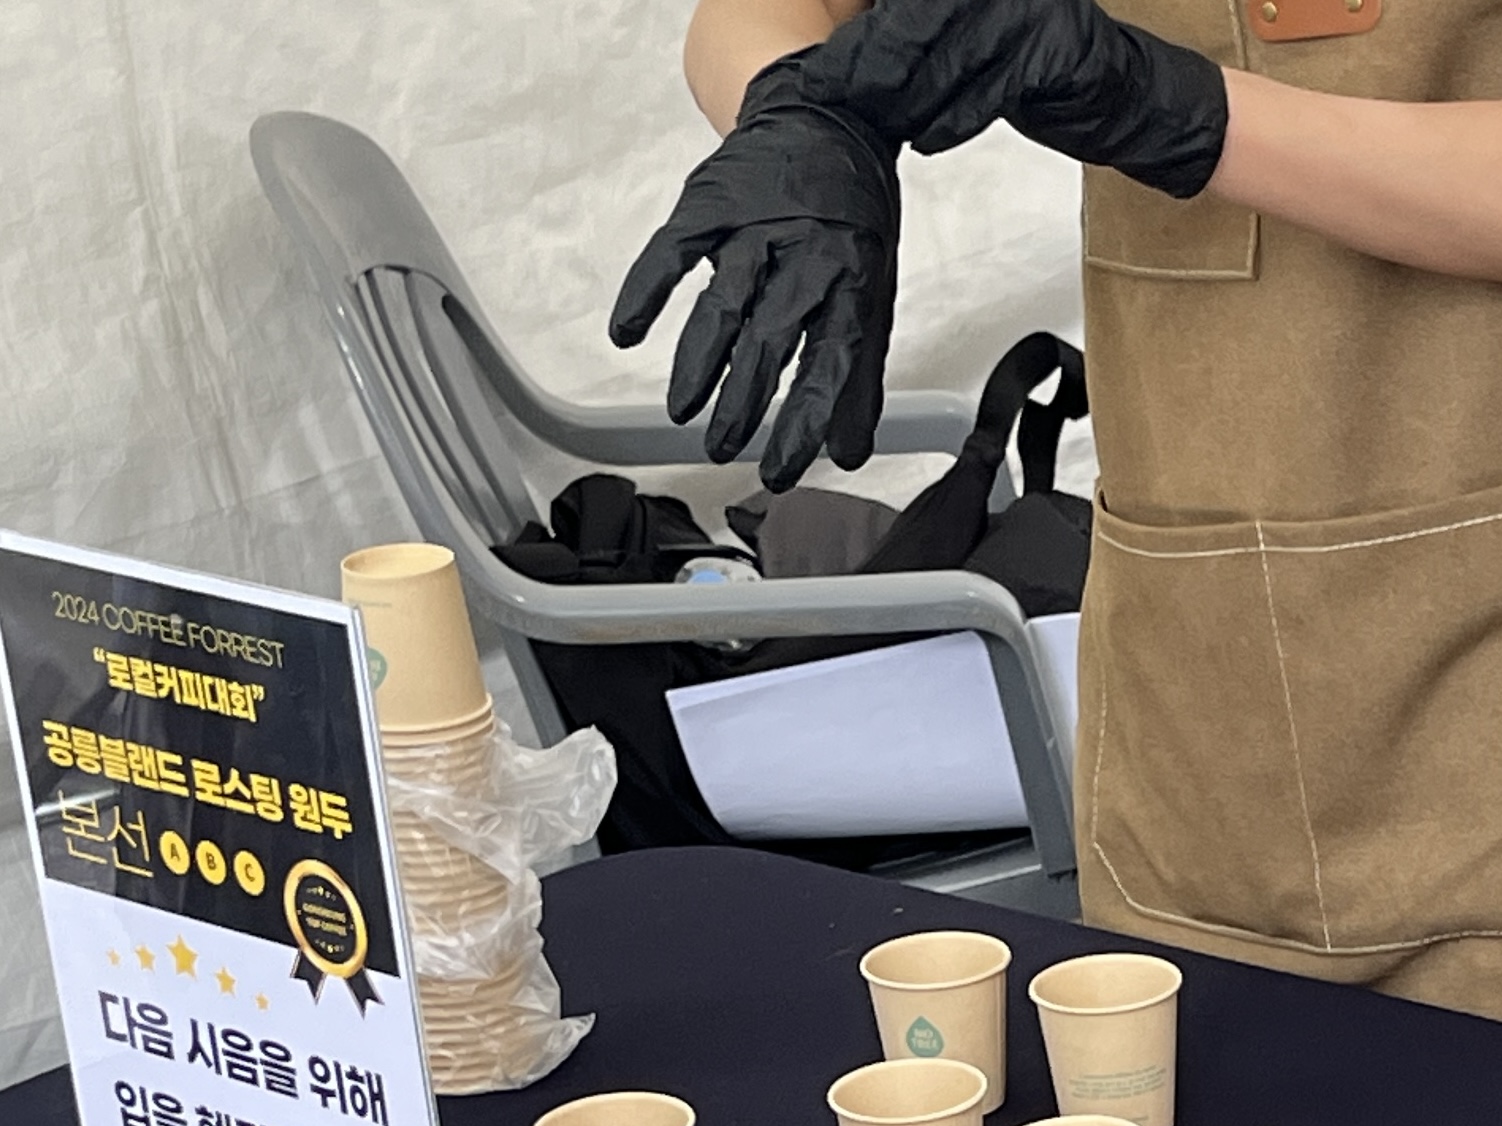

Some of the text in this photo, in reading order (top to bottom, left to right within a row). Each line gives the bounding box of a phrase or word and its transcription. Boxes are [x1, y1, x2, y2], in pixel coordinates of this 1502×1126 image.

[52, 591, 284, 668] 2024 COFFEE FORREST
[57, 789, 153, 878] 본선
[191, 758, 284, 822] 로스팅
[288, 783, 353, 840] 원두
[98, 990, 175, 1061] 다음
[187, 1018, 299, 1099] 시음을
